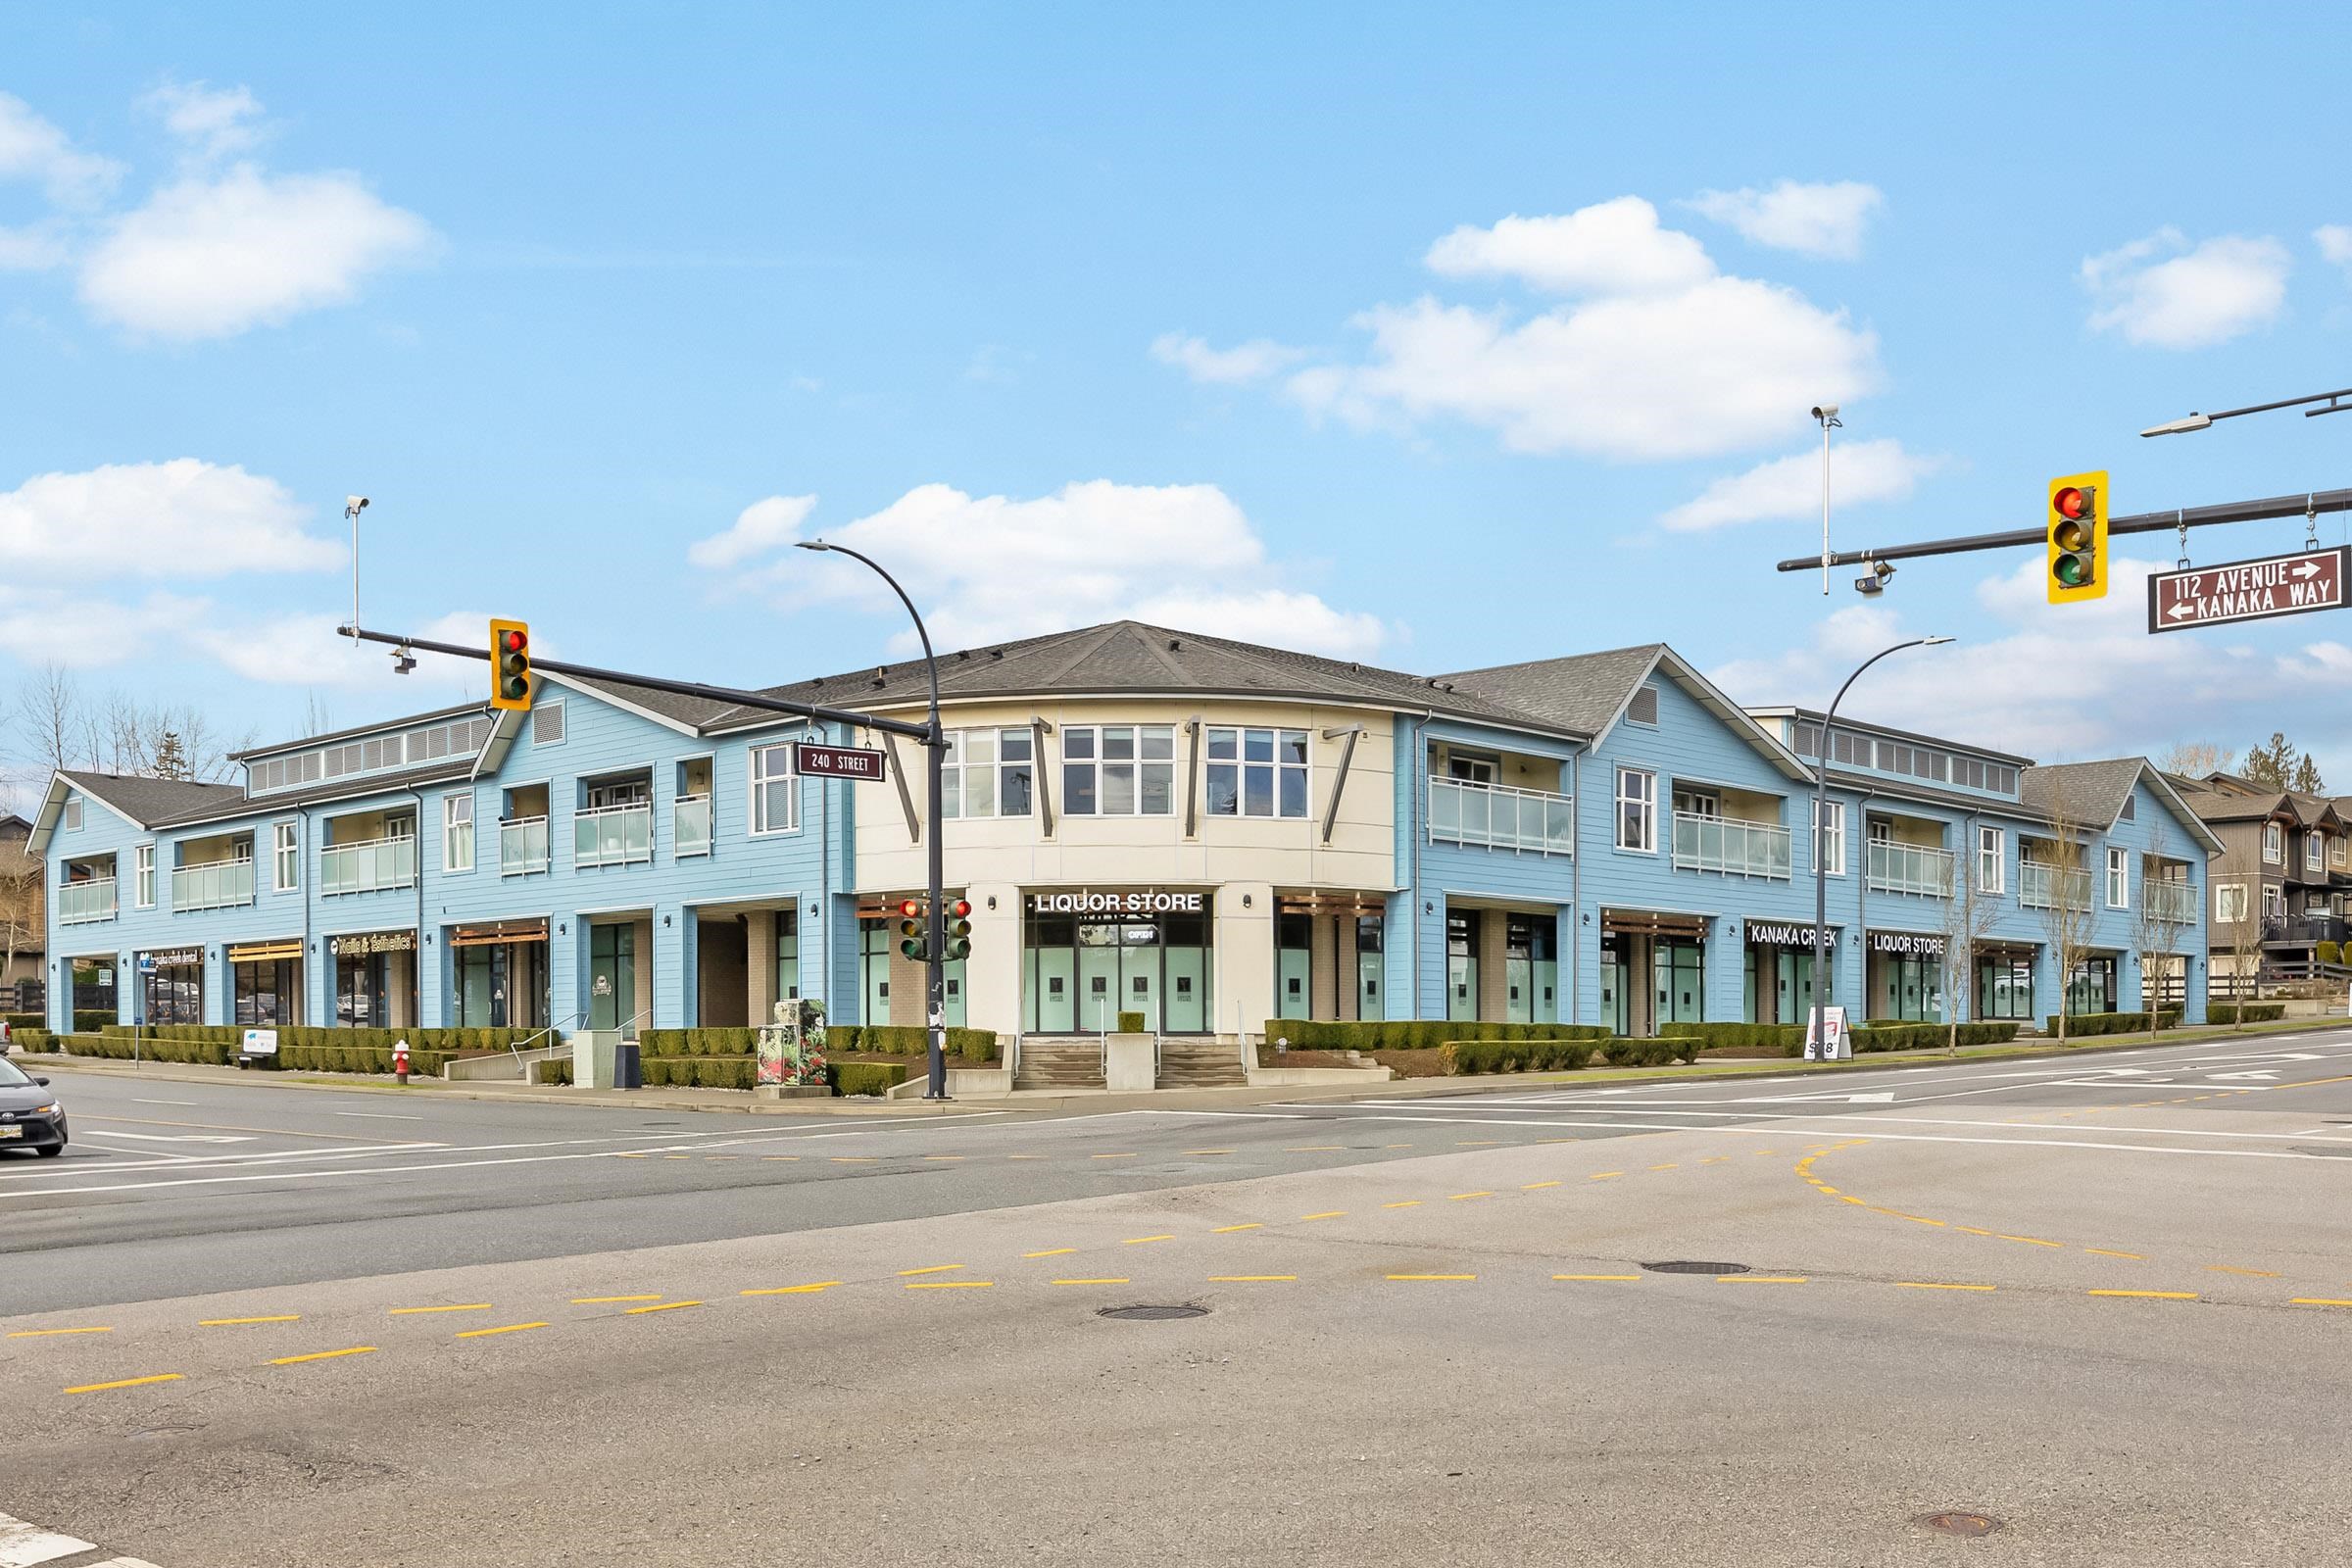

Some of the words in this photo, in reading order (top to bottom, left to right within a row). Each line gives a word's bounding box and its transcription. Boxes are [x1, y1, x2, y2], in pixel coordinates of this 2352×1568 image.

[2175, 575, 2201, 600] 112
[2216, 563, 2288, 594] AVENUE
[2197, 588, 2275, 619] KANAKA
[2290, 578, 2330, 606] WAY
[811, 754, 830, 768] 240
[837, 756, 868, 771] STREET
[1037, 894, 1120, 911] LIQUOR
[1127, 894, 1200, 911] STORE
[1128, 930, 1153, 939] OPEN
[1751, 925, 1799, 945] KANAKA
[1800, 928, 1837, 947] CREK
[339, 938, 361, 955] Nails
[361, 937, 369, 953] &
[1874, 934, 1911, 953] LIQUOR
[1913, 937, 1944, 955] STORE
